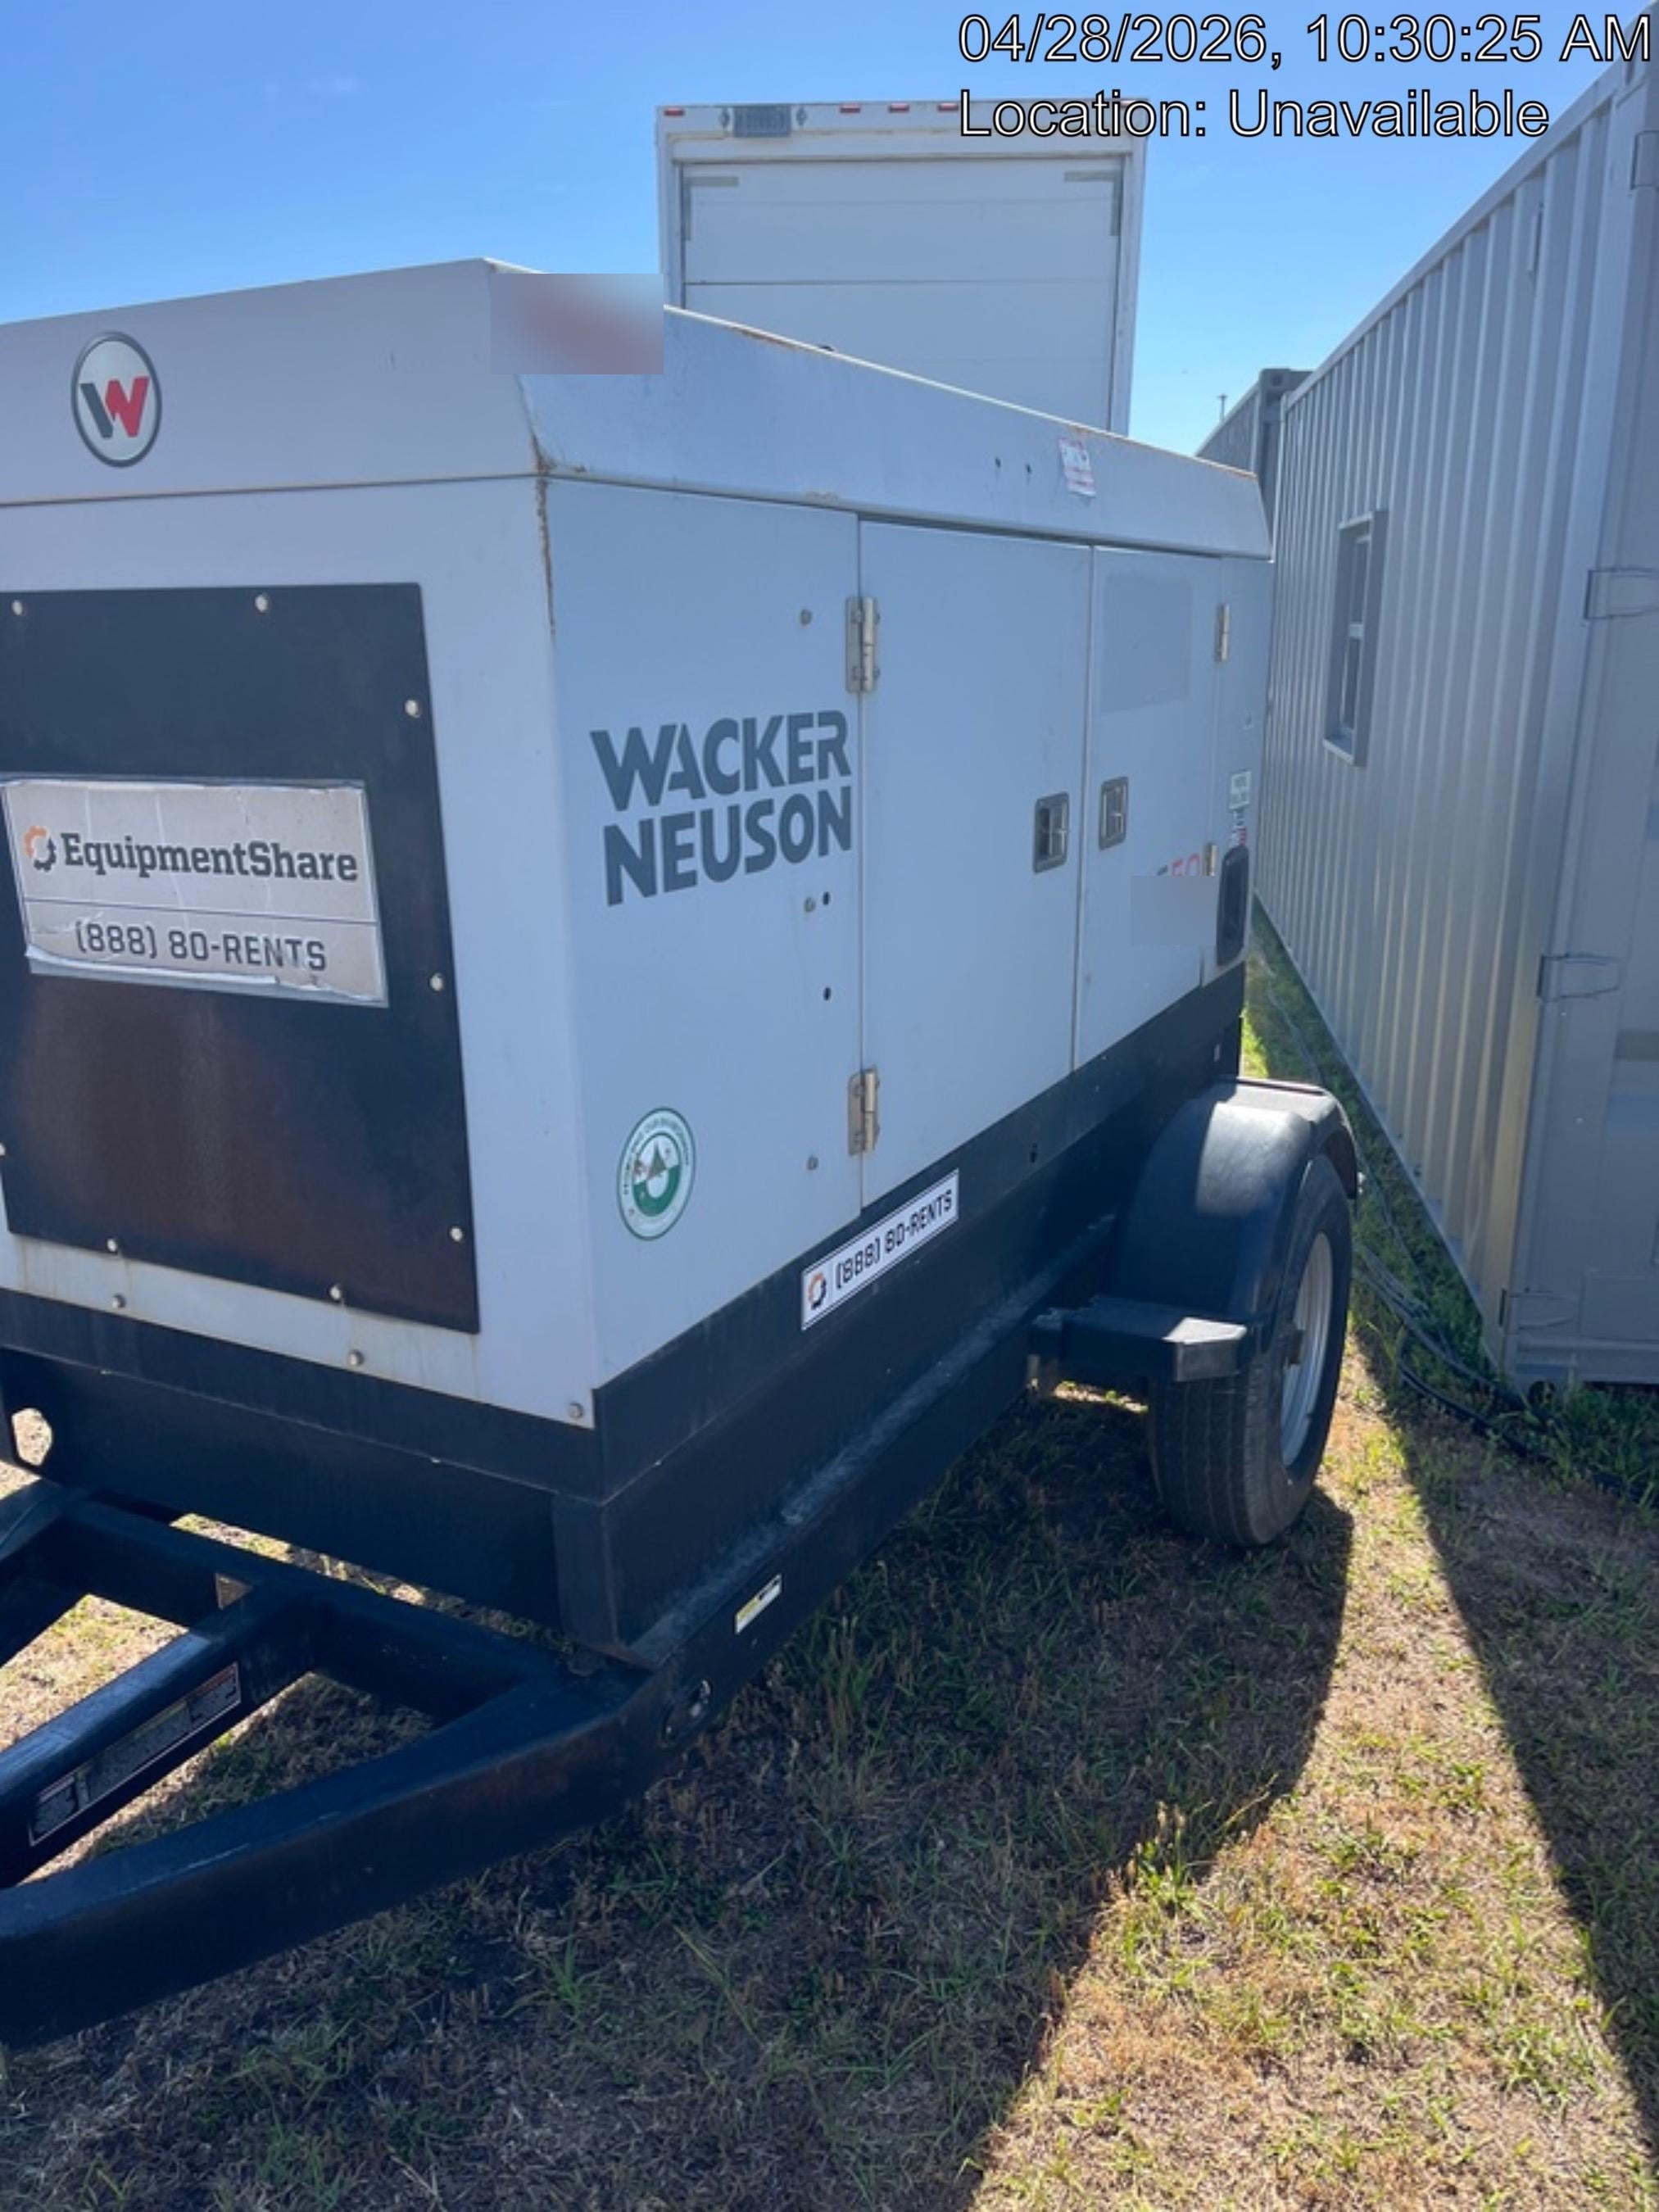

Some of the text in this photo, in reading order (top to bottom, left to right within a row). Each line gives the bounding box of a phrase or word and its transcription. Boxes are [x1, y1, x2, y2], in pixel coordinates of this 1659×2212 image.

[80, 376, 149, 439] W
[589, 709, 851, 811] WACKER
[61, 832, 357, 881] EquipmentShare
[604, 786, 851, 906] NEUSON
[76, 920, 326, 972] (888) 80-RENTS
